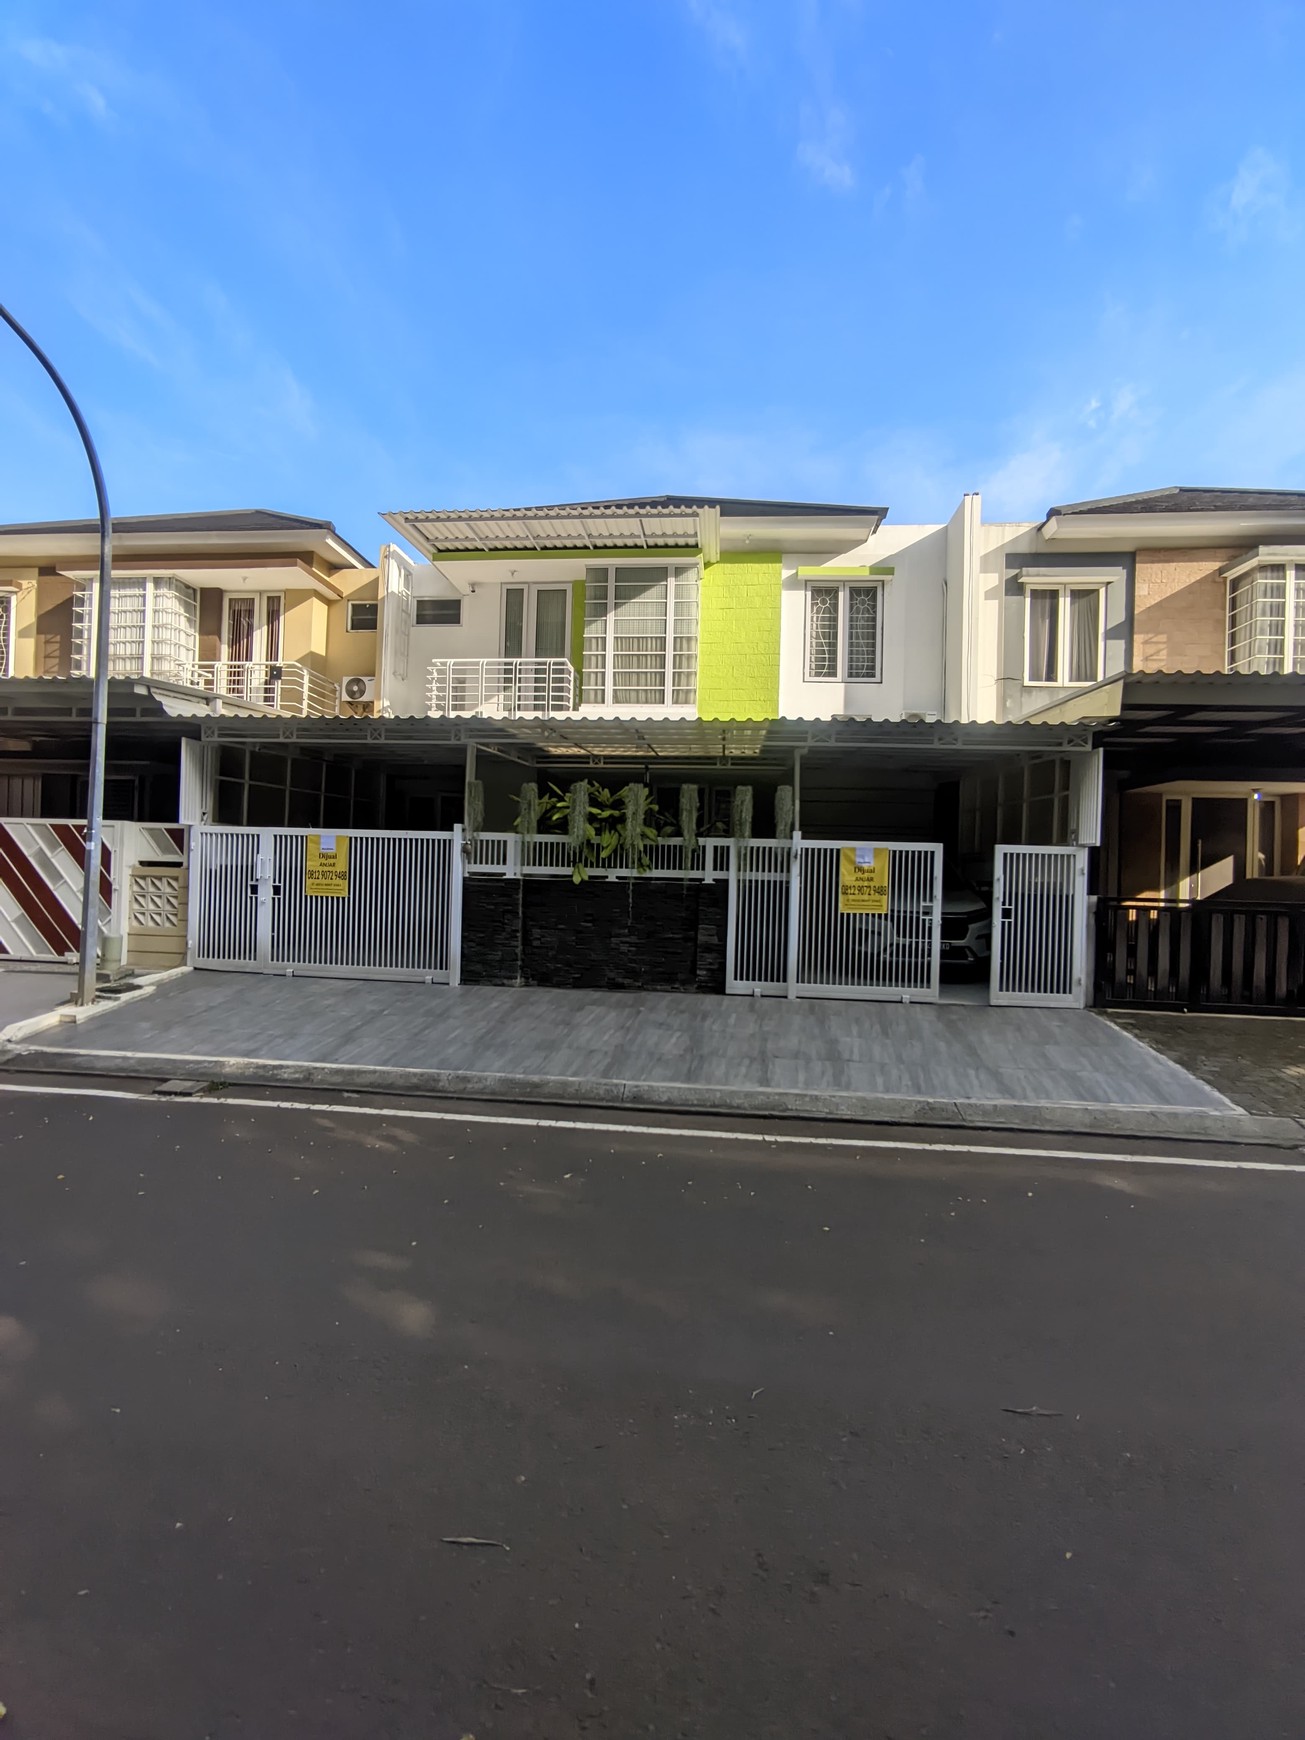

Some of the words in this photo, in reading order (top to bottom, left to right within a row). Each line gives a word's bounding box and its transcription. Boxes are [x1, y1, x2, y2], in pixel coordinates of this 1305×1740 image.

[319, 852, 338, 860] Dijual
[308, 870, 320, 880] 0812
[321, 870, 333, 880] 9072
[335, 871, 347, 881] 9488
[854, 866, 875, 875] Dijual
[841, 884, 856, 895] 0812
[857, 885, 871, 896] 9072
[873, 886, 887, 896] 9488
